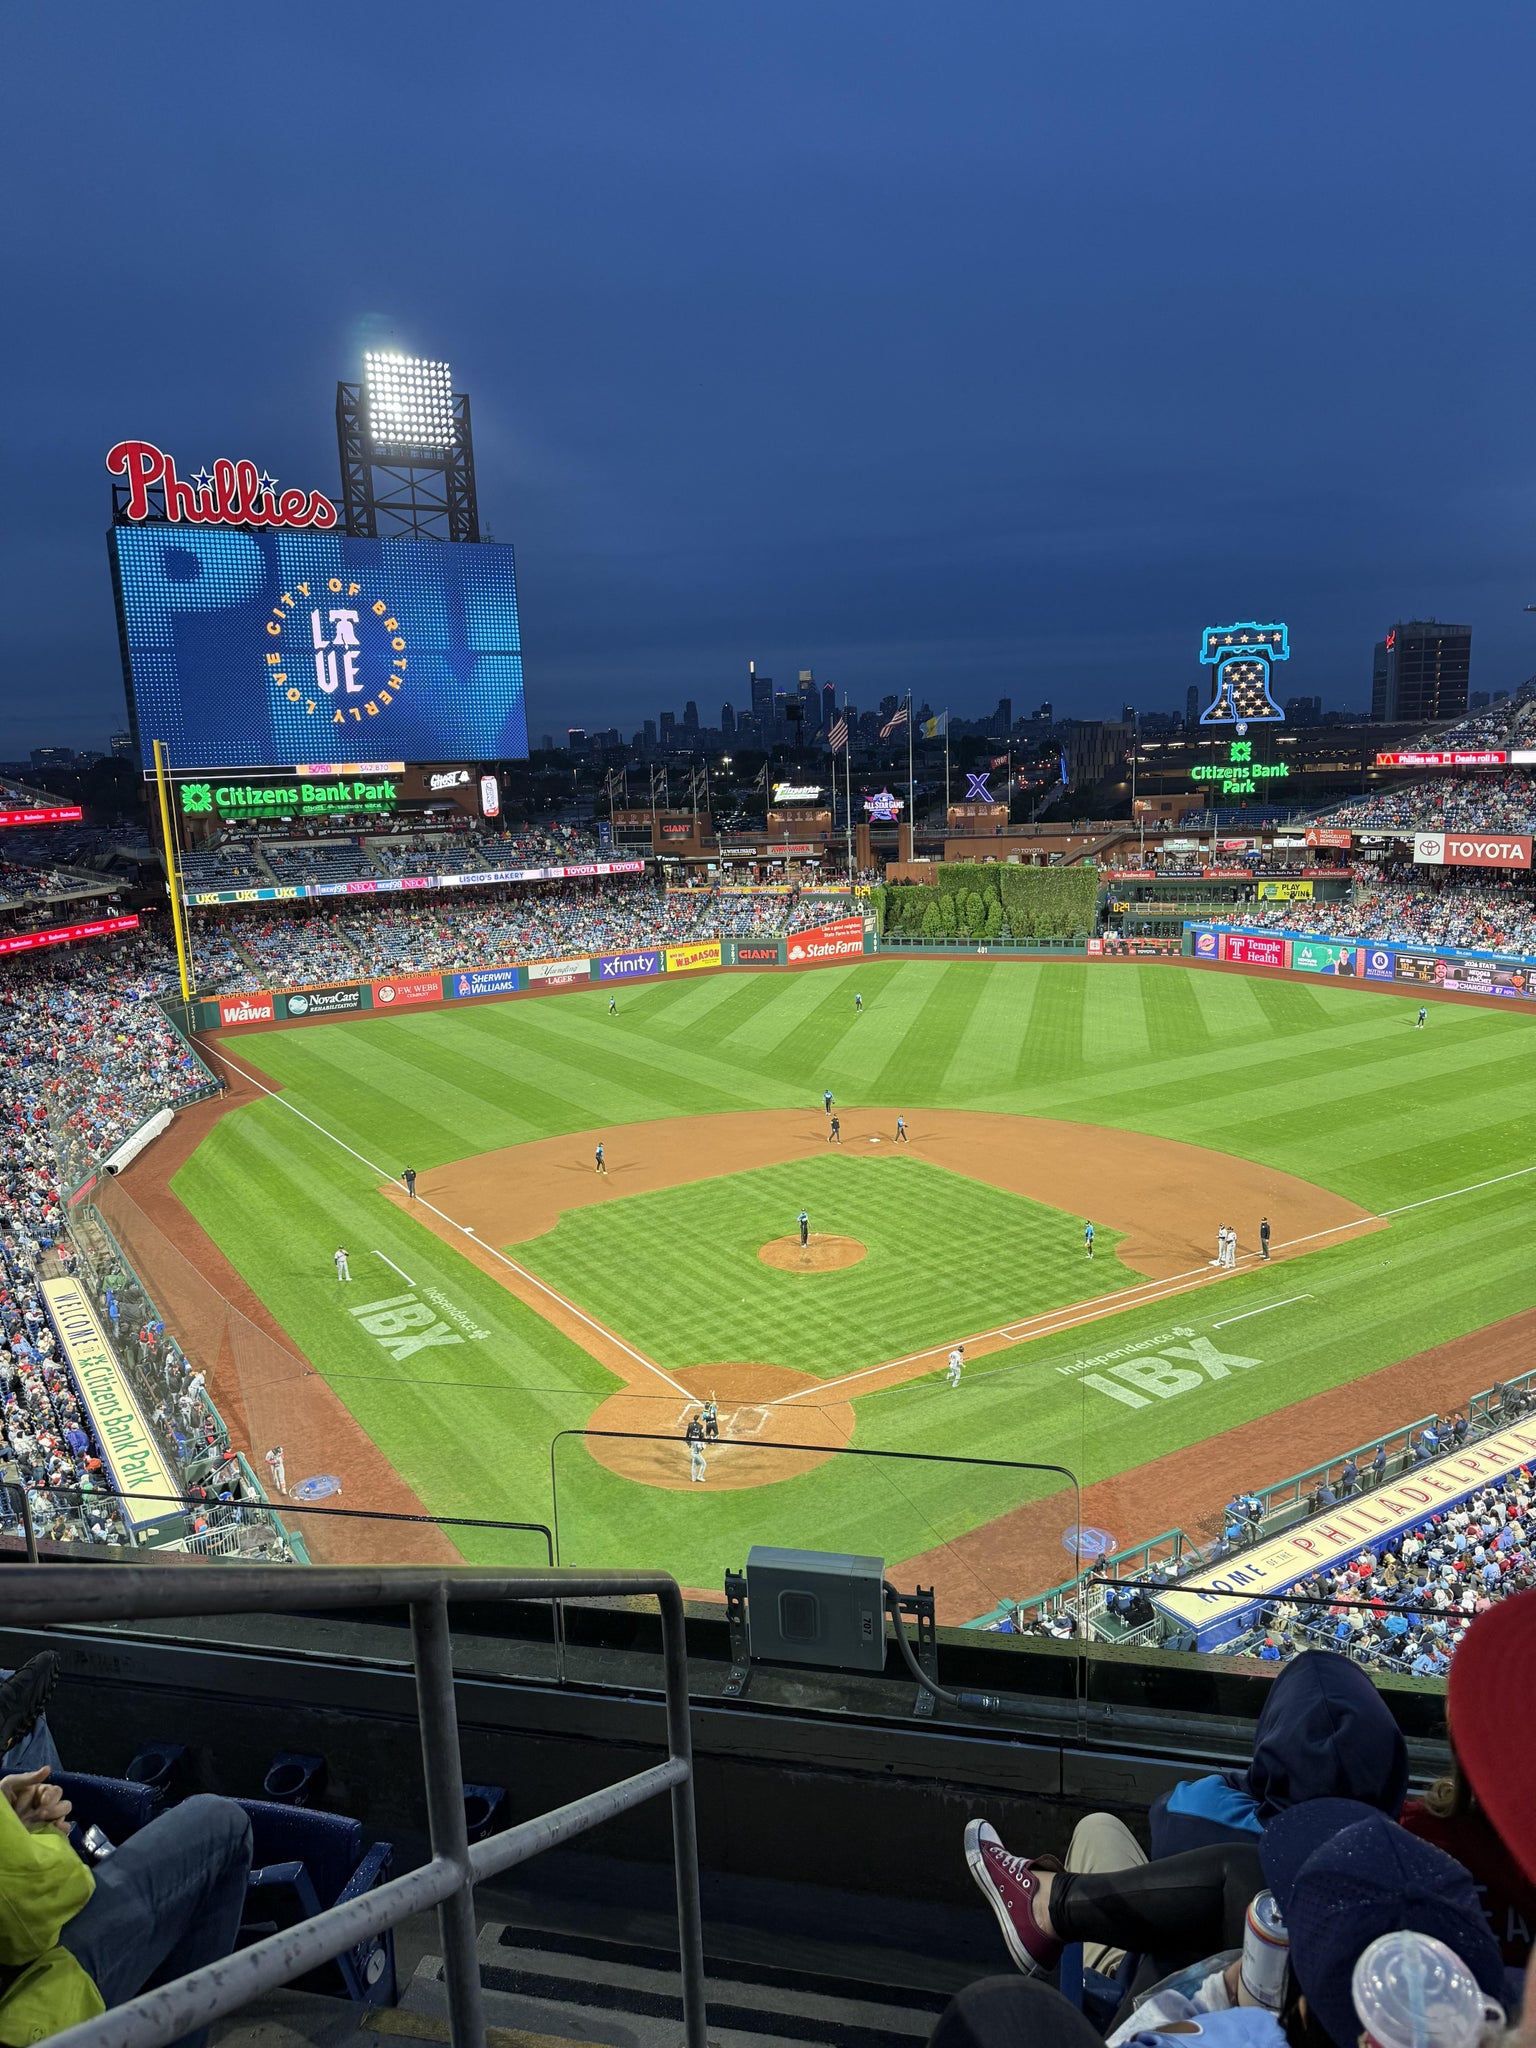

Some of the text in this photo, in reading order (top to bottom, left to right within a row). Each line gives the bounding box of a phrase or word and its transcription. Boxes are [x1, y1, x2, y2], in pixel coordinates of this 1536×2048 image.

[106, 440, 338, 528] Phillies
[266, 578, 407, 723] CITY OF BROTHERLY LOVE
[1398, 755, 1424, 763] Phillies
[1191, 763, 1289, 780] Citizens Bank
[1222, 779, 1256, 794] Park
[215, 780, 397, 806] Citizens Bank Park
[662, 824, 691, 832] GIANT
[1449, 842, 1524, 860] TOYOTA
[566, 866, 596, 875] TOYOTA
[611, 863, 640, 871] TOYOTA
[459, 871, 524, 883] LISCIO'S BAKERY
[350, 881, 374, 892] NECA
[404, 879, 428, 888] NECA
[236, 890, 259, 900] UKG
[275, 887, 298, 897] UKG
[196, 893, 219, 904] UKG
[1113, 902, 1130, 912] 0:29
[977, 946, 988, 954] 401
[1248, 940, 1281, 953] Temple
[738, 949, 777, 959] GIANT
[1248, 952, 1279, 964] Health
[541, 963, 579, 976] Yuengling
[603, 955, 654, 976] xfinity
[472, 972, 511, 984] SHERWIN
[548, 976, 573, 985] LAGER
[266, 987, 304, 996] ASPLUNDH
[312, 982, 349, 990] ASPLUNDH
[414, 983, 438, 992] WEBB
[1459, 983, 1493, 993] CHANGEUP
[220, 992, 259, 1000] ASPLUNDH
[309, 991, 359, 1006] NovaCare
[310, 1002, 357, 1012] REHABILITATION
[223, 1006, 271, 1023] Wawa
[422, 1286, 478, 1331] Independence
[53, 1292, 98, 1347] WELCOME
[348, 1292, 465, 1361] IBX
[1055, 1333, 1175, 1375] Independence
[1077, 1336, 1264, 1409] IBX
[83, 1366, 161, 1490] Citizens Bank Park
[1195, 1563, 1268, 1604] HOME
[862, 1617, 872, 1636] 707
